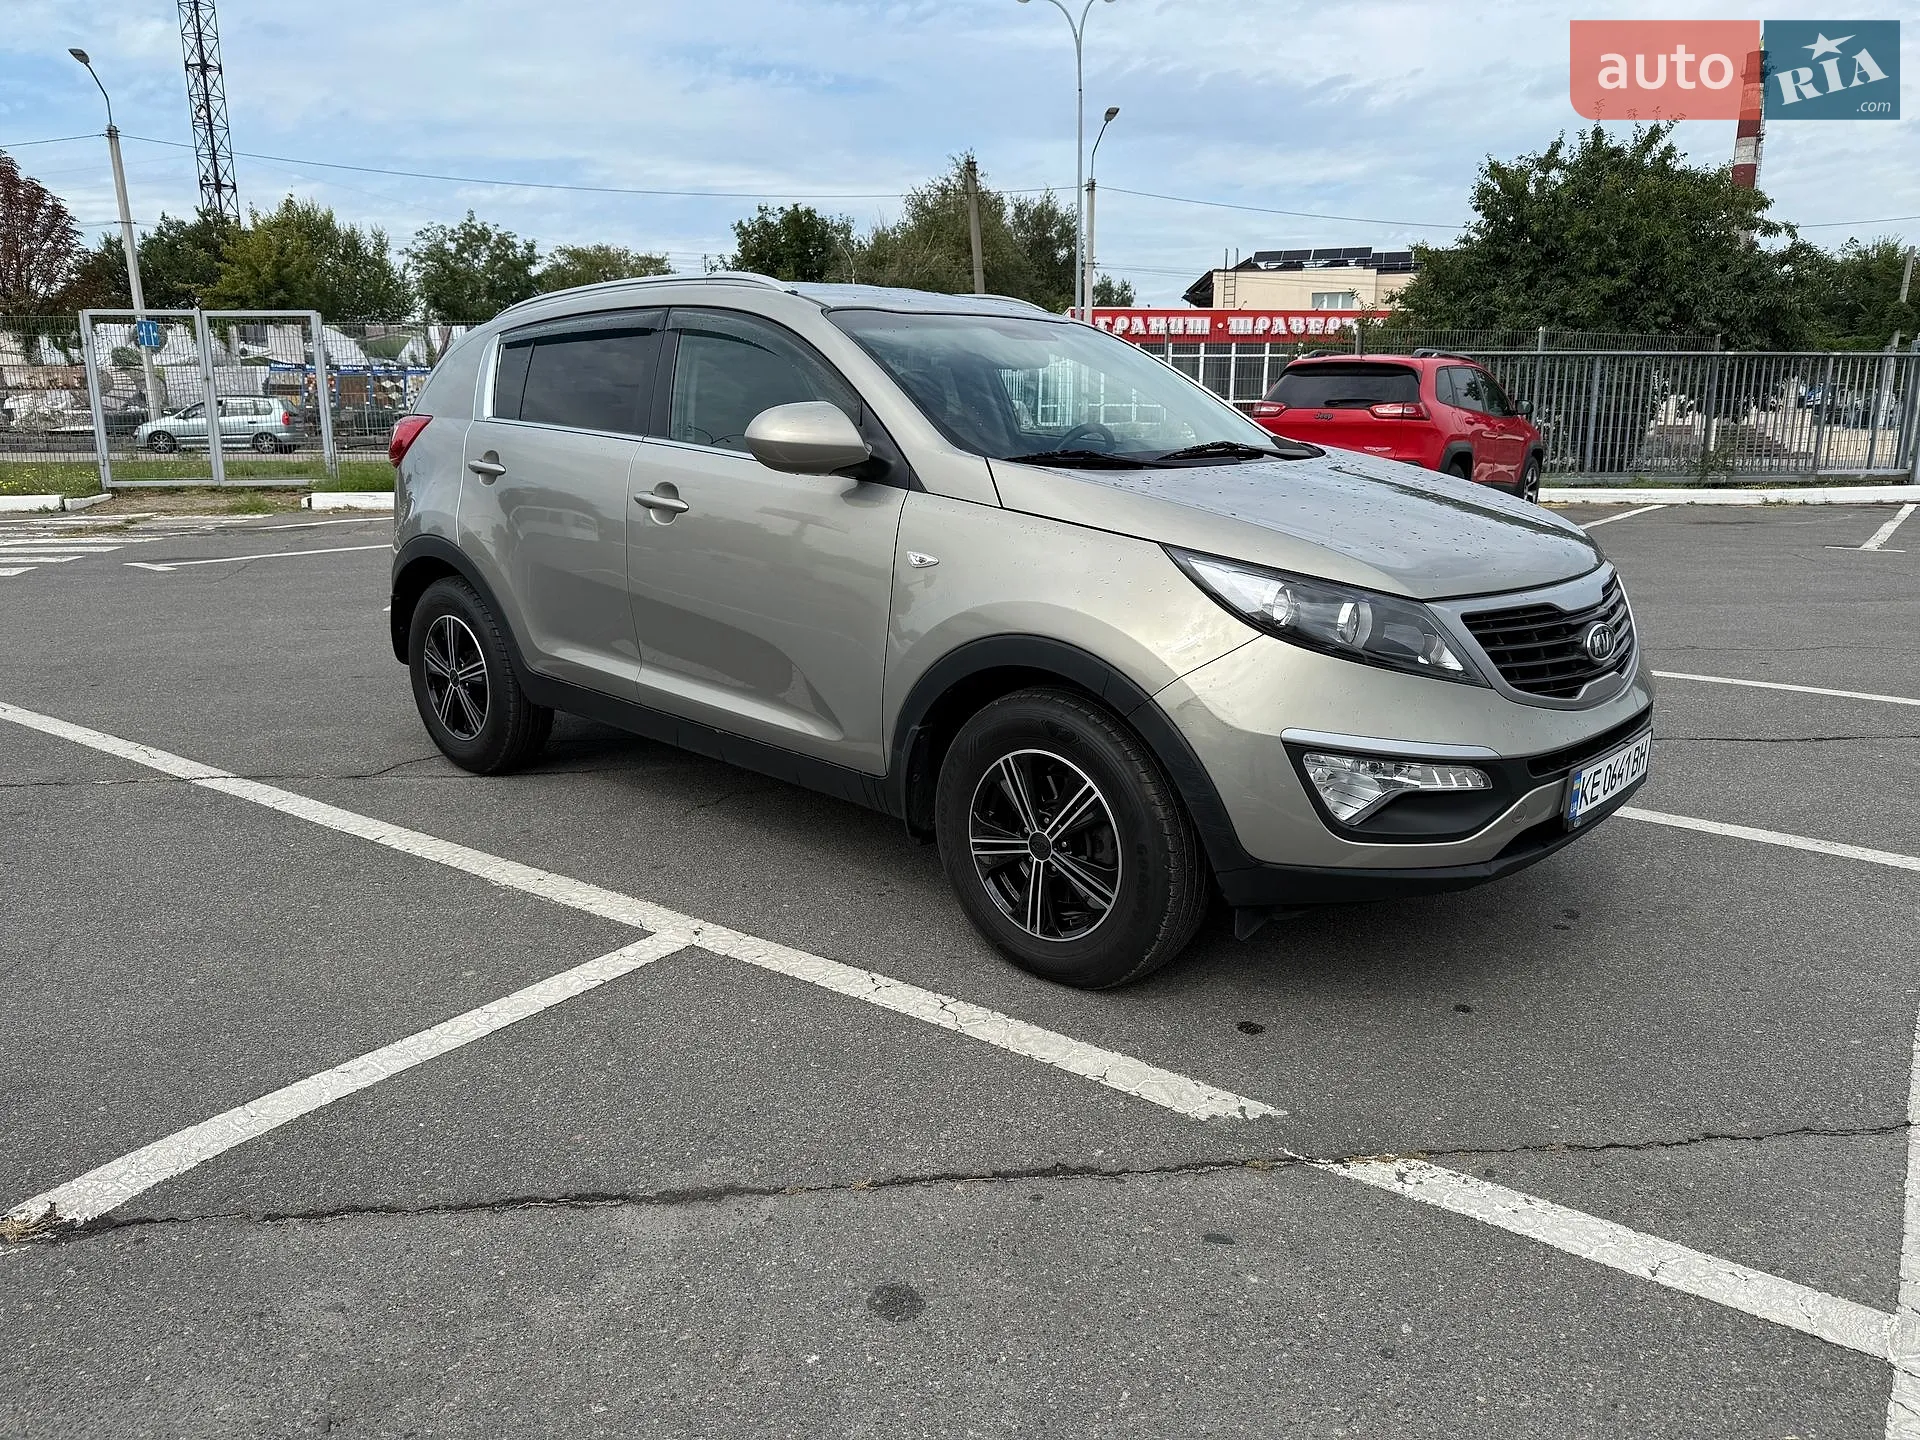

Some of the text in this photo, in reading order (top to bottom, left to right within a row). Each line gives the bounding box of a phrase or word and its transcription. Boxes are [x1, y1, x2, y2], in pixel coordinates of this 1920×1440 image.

[1227, 315, 1384, 335] ТРАВЕР
[1579, 739, 1648, 810] KE 0641 BH
